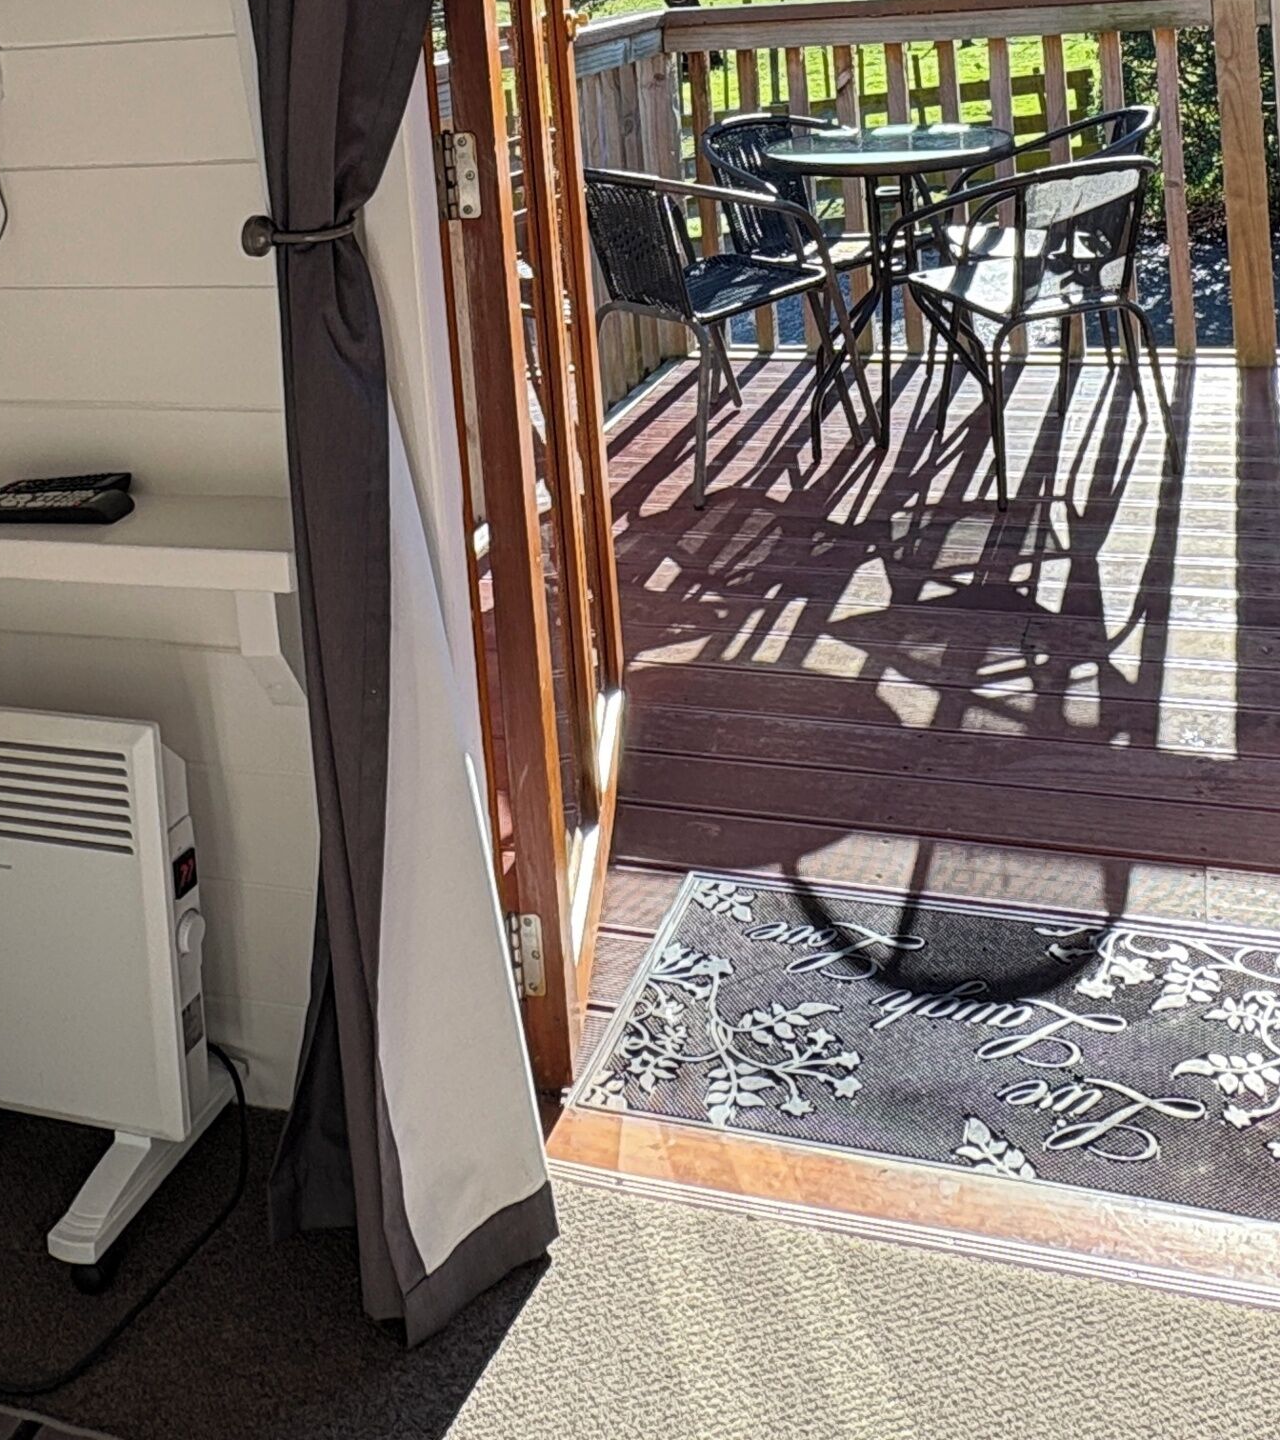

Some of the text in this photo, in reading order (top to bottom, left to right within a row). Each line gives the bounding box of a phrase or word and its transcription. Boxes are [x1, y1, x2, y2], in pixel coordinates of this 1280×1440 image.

[743, 921, 927, 981] Love
[869, 980, 1128, 1070] Laugh
[996, 1076, 1207, 1162] Live
